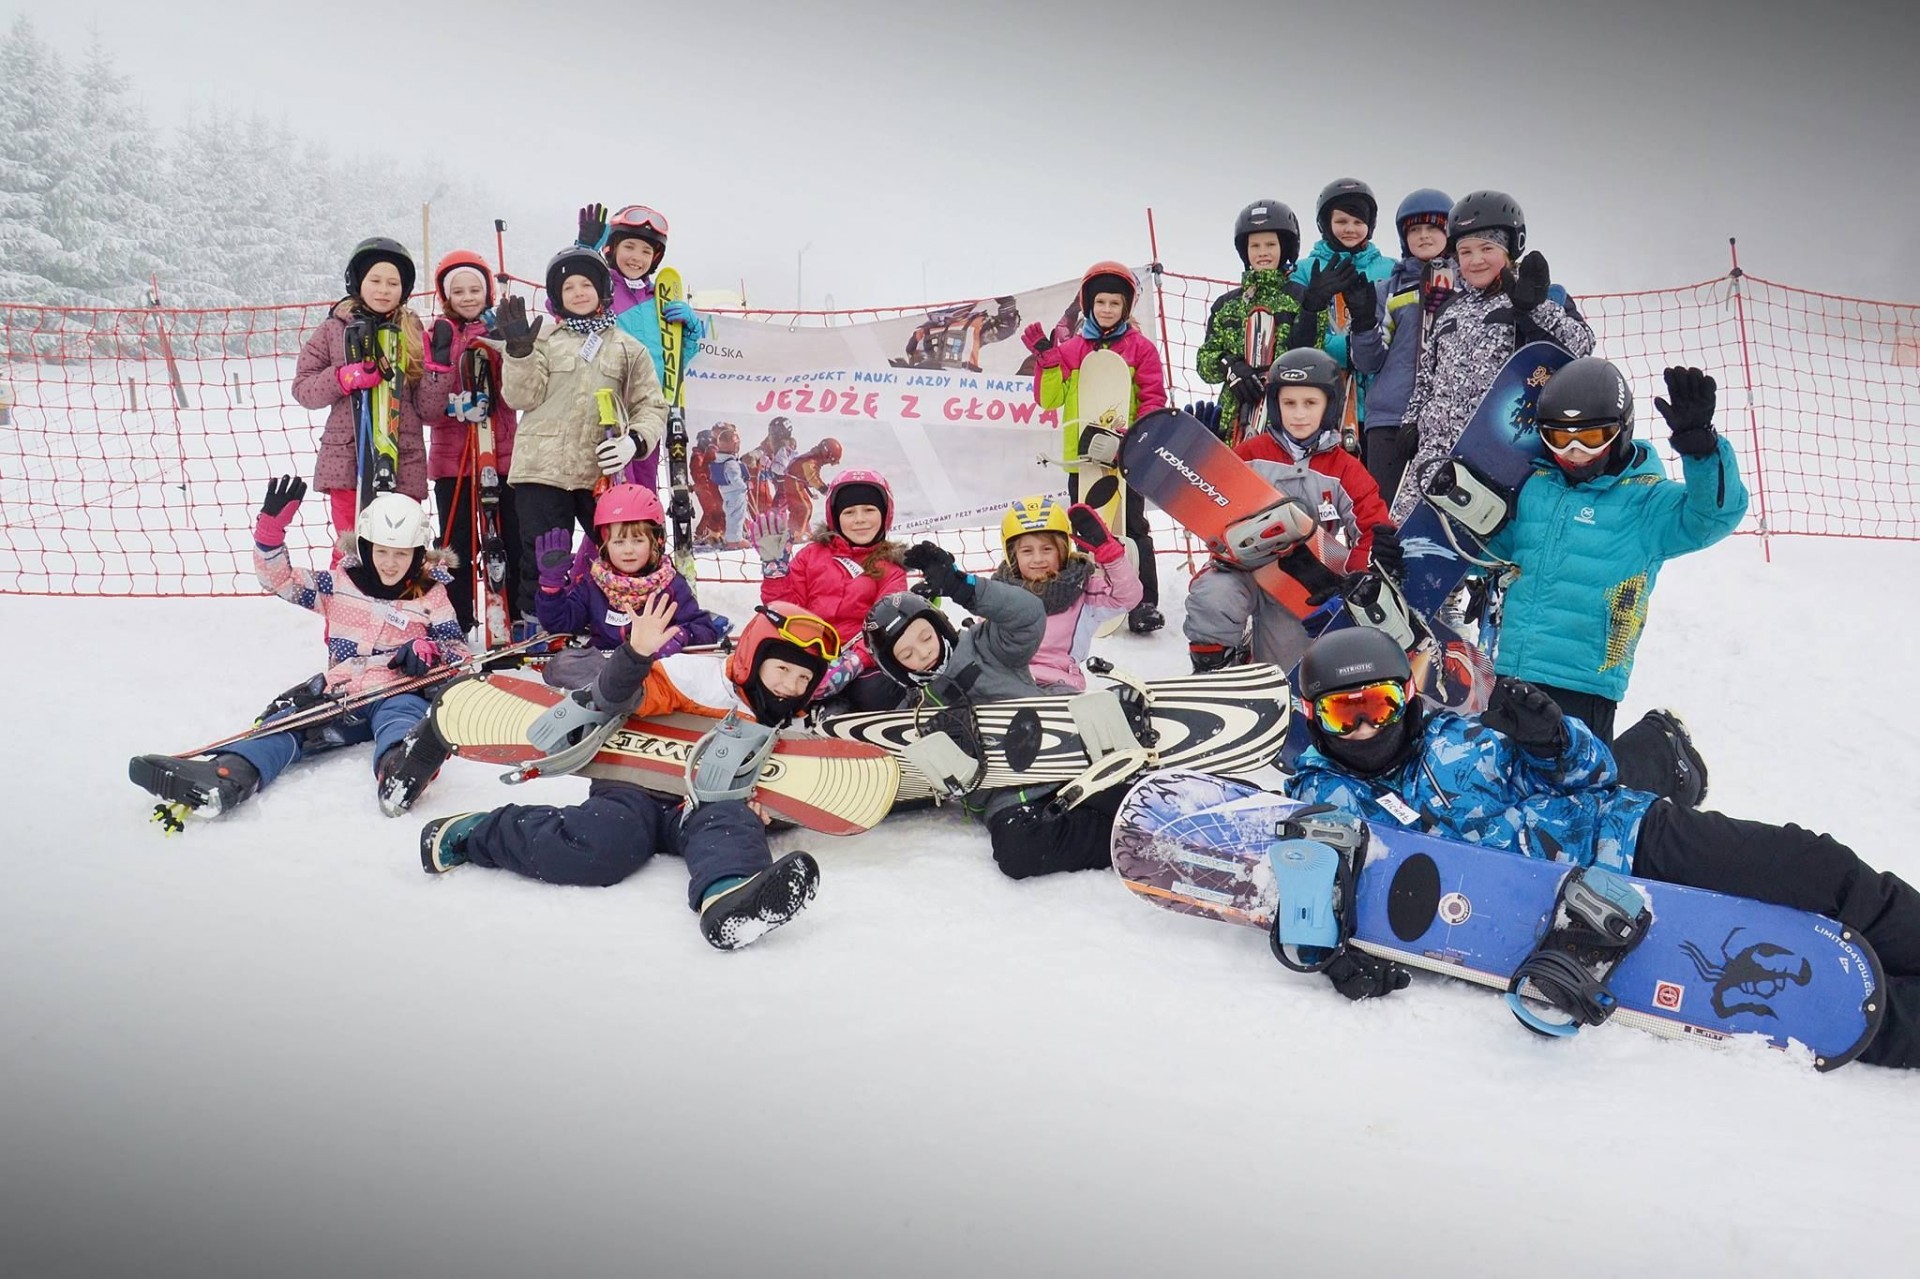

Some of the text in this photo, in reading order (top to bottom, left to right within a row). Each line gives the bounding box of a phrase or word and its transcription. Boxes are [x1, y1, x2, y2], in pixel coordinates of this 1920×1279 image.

[698, 342, 744, 359] POLSKA
[685, 367, 1033, 393] MAŁOPOLSKI PROJEKT NAUKI JAZDY NA NARTA
[756, 383, 880, 419] JEŻDŻĘ
[900, 394, 921, 419] Z
[906, 514, 951, 529] REALIZOWANY
[976, 502, 1009, 514] WSPARCIU
[1339, 662, 1373, 675] PATRIOTIC
